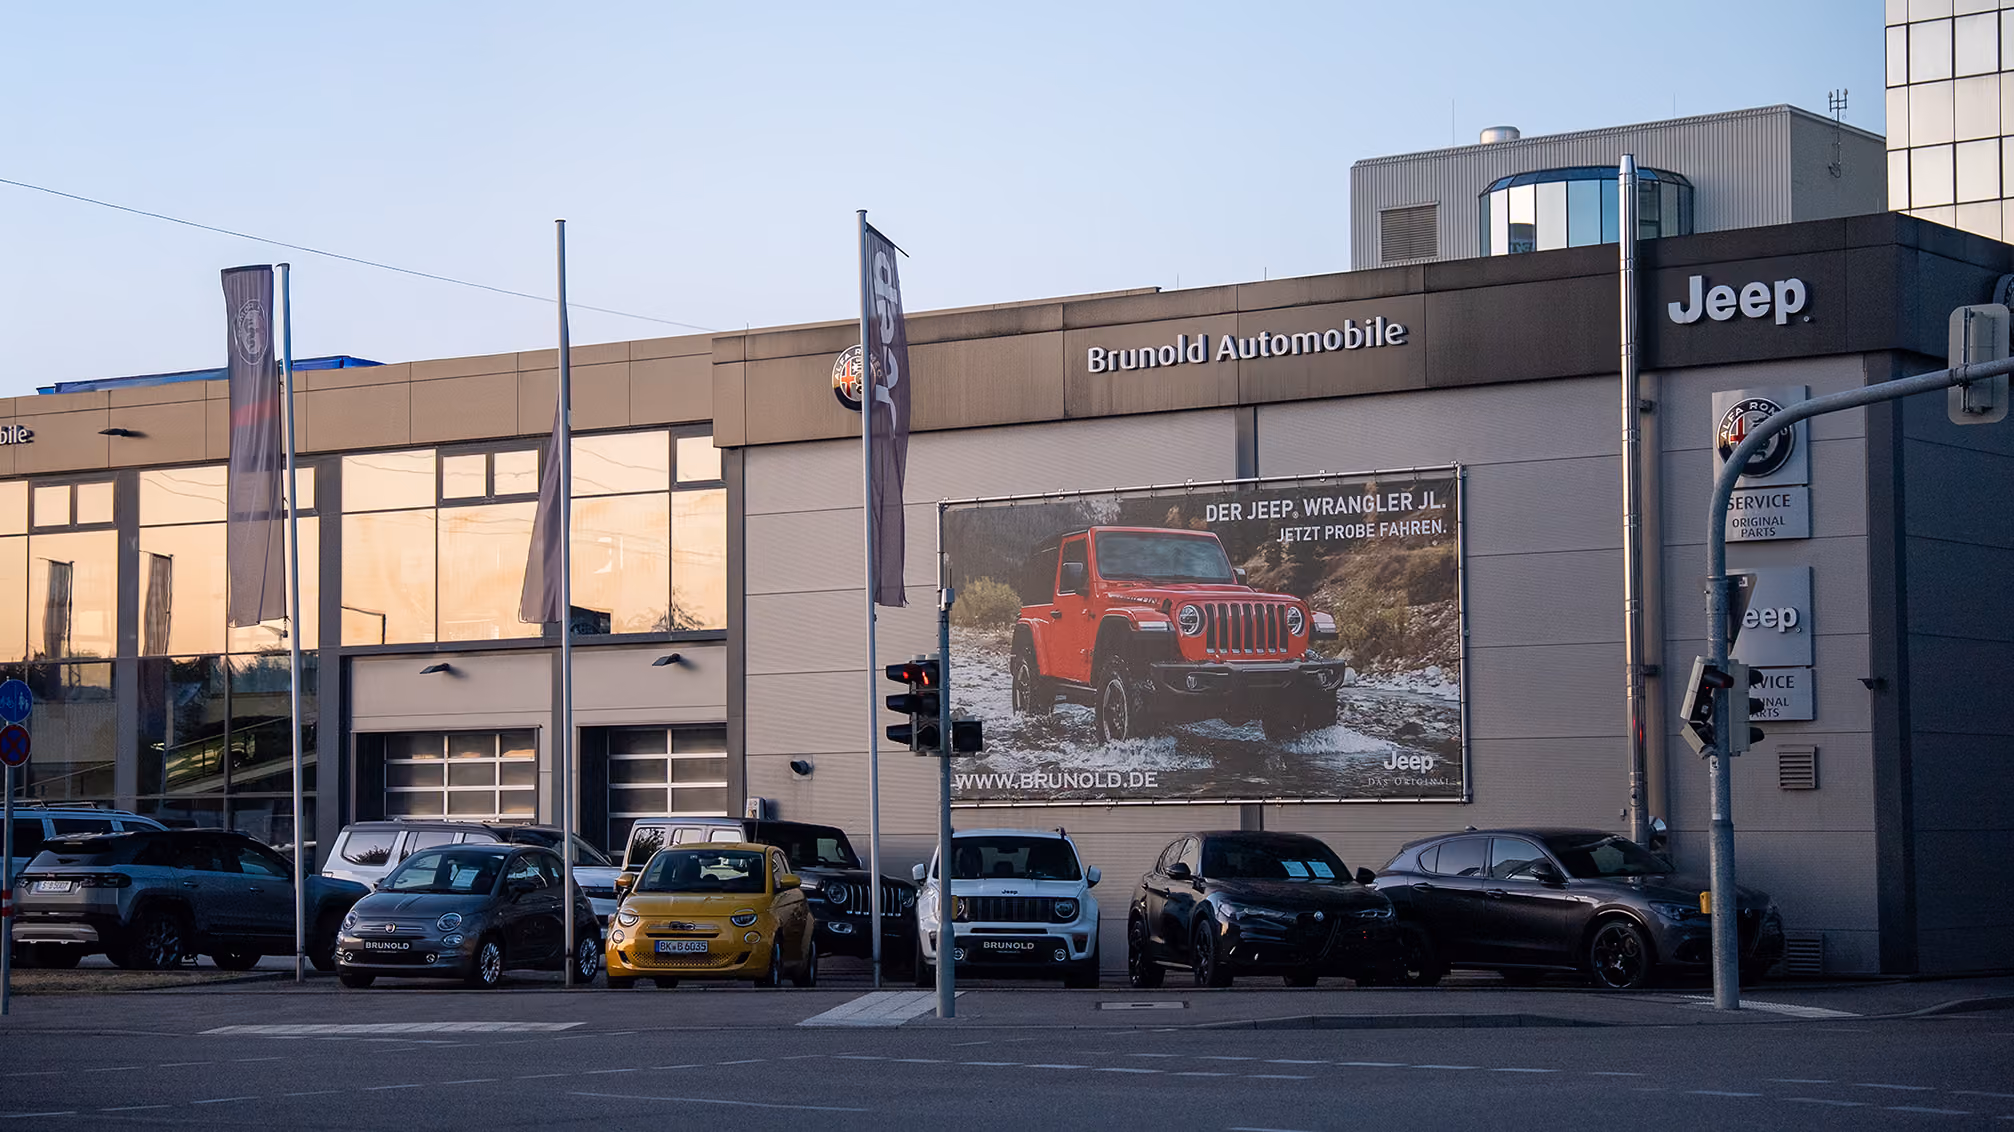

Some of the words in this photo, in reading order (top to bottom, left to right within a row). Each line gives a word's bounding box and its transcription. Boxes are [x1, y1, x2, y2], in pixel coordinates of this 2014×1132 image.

[1087, 333, 1208, 374] Brunold
[1215, 315, 1406, 363] Automobile
[1720, 408, 1744, 440] ALFA
[1205, 502, 1243, 522] DER
[1302, 492, 1413, 517] WRANGLER
[1727, 493, 1791, 511] SERVICE
[1276, 525, 1321, 543] JETZT
[1324, 522, 1376, 541] PROBE
[1379, 519, 1448, 538] FAHREN.
[1731, 516, 1786, 528] ORIGINAL
[1740, 526, 1776, 538] PARTS
[1742, 606, 1798, 633] eep
[1749, 675, 1795, 689] VICE
[1751, 707, 1780, 718] ARTS
[1383, 750, 1434, 774] Jeep
[954, 771, 1159, 790] WWW.BRUNOLD.DE
[365, 941, 410, 950] BRUNOLD
[983, 941, 1035, 950] BRUNOLD
